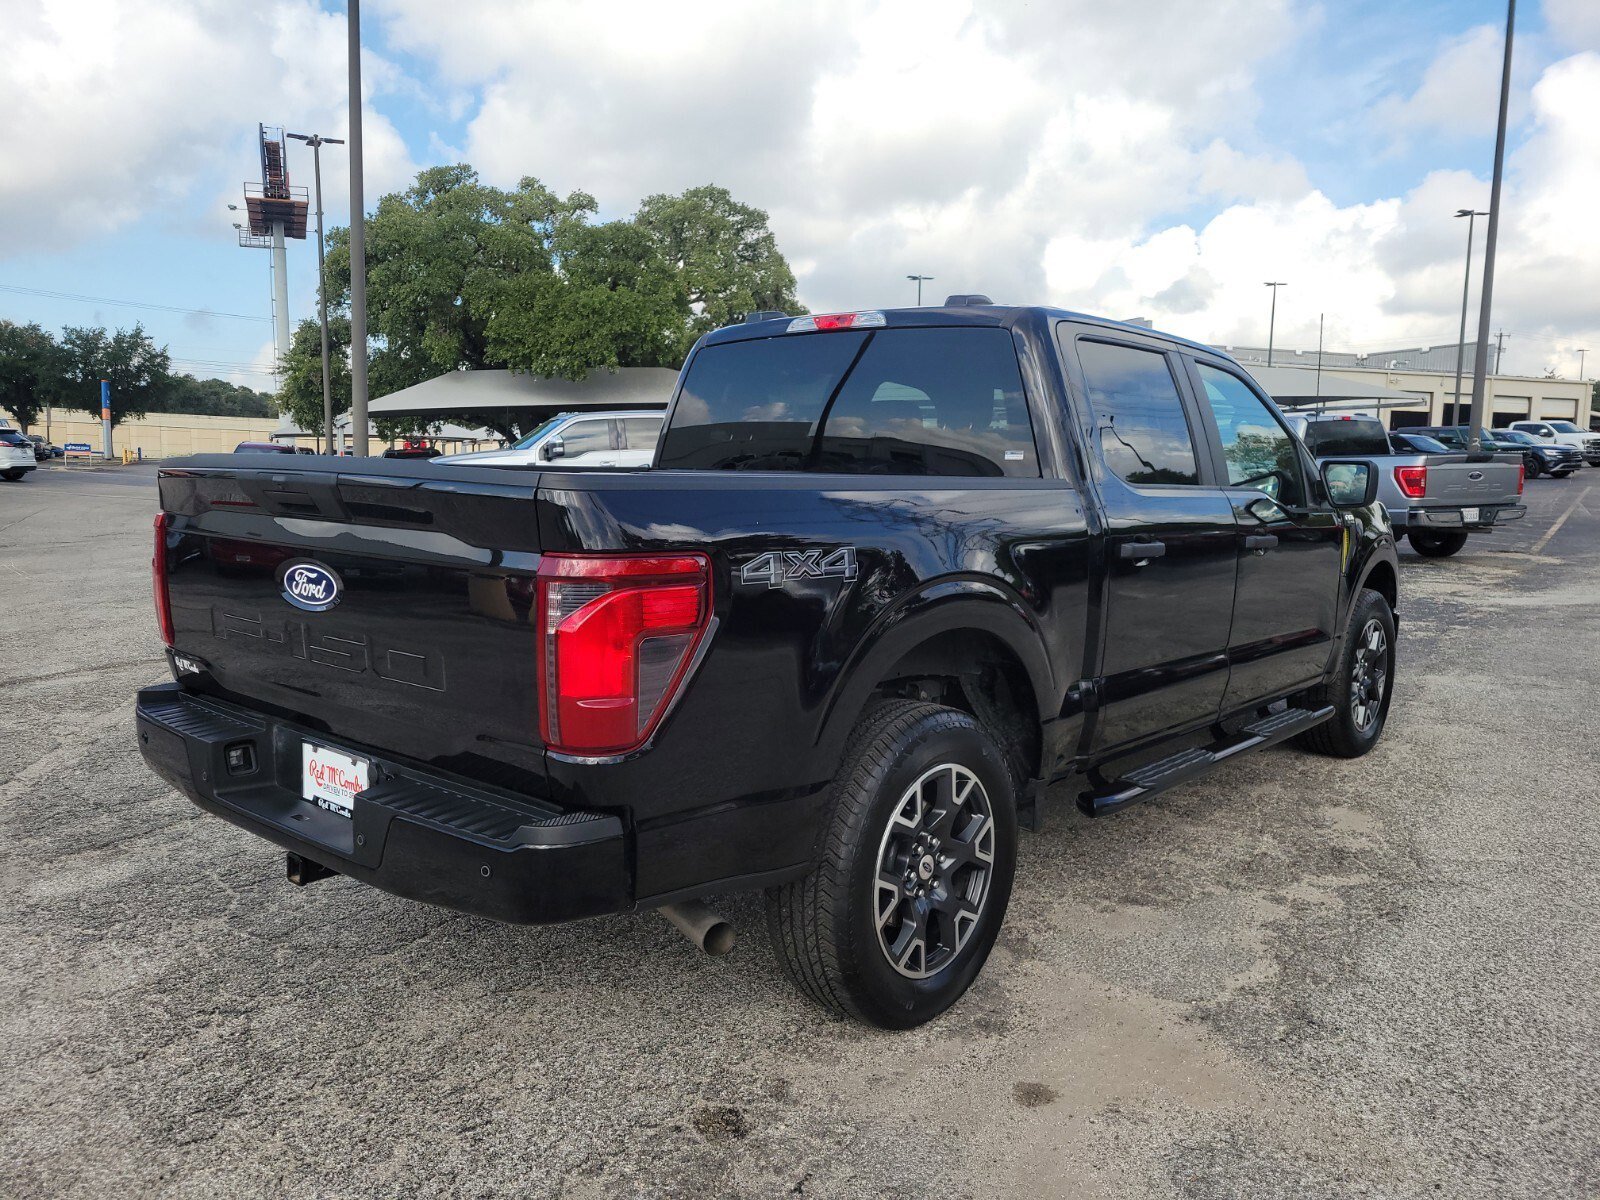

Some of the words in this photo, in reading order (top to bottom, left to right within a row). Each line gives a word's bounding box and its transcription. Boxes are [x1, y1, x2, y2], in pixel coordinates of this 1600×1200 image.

[292, 569, 327, 599] Ford
[211, 605, 447, 693] F-150
[309, 759, 325, 787] Red
[341, 789, 349, 797] TO
